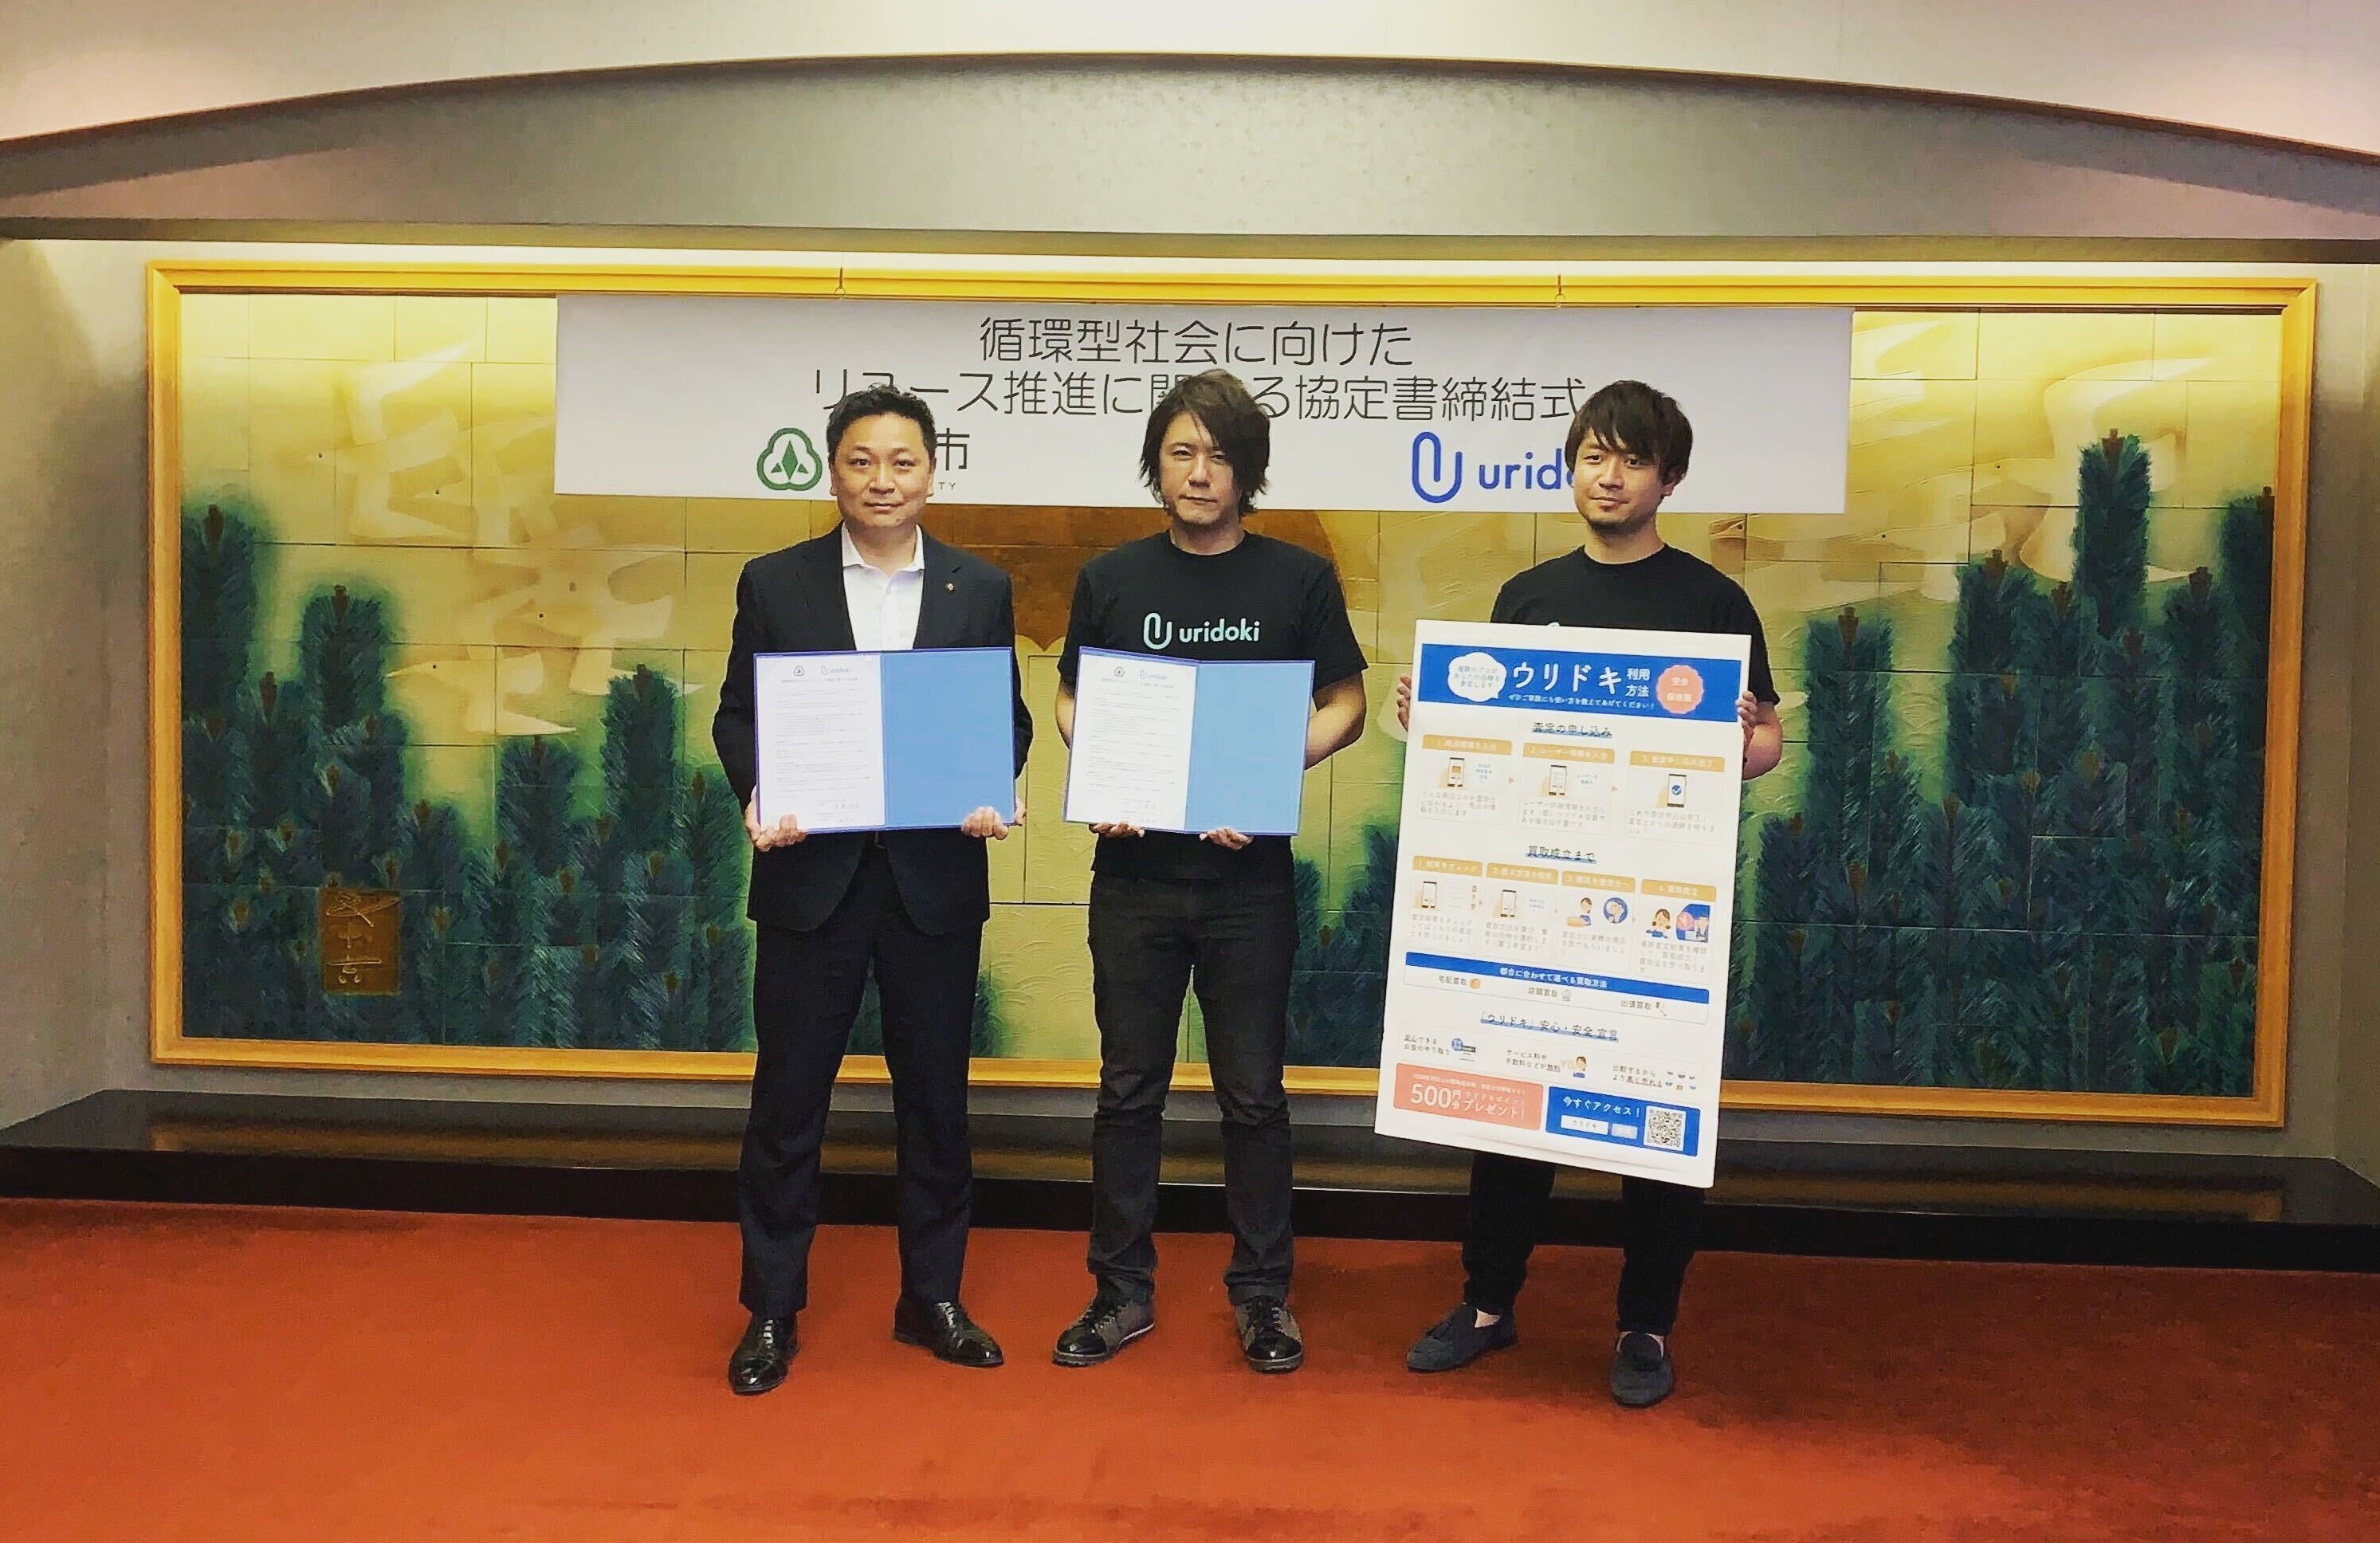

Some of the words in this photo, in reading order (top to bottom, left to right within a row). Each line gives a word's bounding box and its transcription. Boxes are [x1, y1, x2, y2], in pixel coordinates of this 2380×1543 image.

[980, 316, 1413, 366] 循環型社会に向けた
[1479, 448, 1575, 490] urid
[1178, 618, 1261, 643] uridoki
[1513, 661, 1622, 695] ウリドキ
[1626, 668, 1651, 681] 利用
[1625, 685, 1651, 697] 方法
[1533, 722, 1612, 737] 査定の申し込み
[1528, 845, 1596, 862] 買取成立まで
[1410, 1082, 1451, 1109] 500
